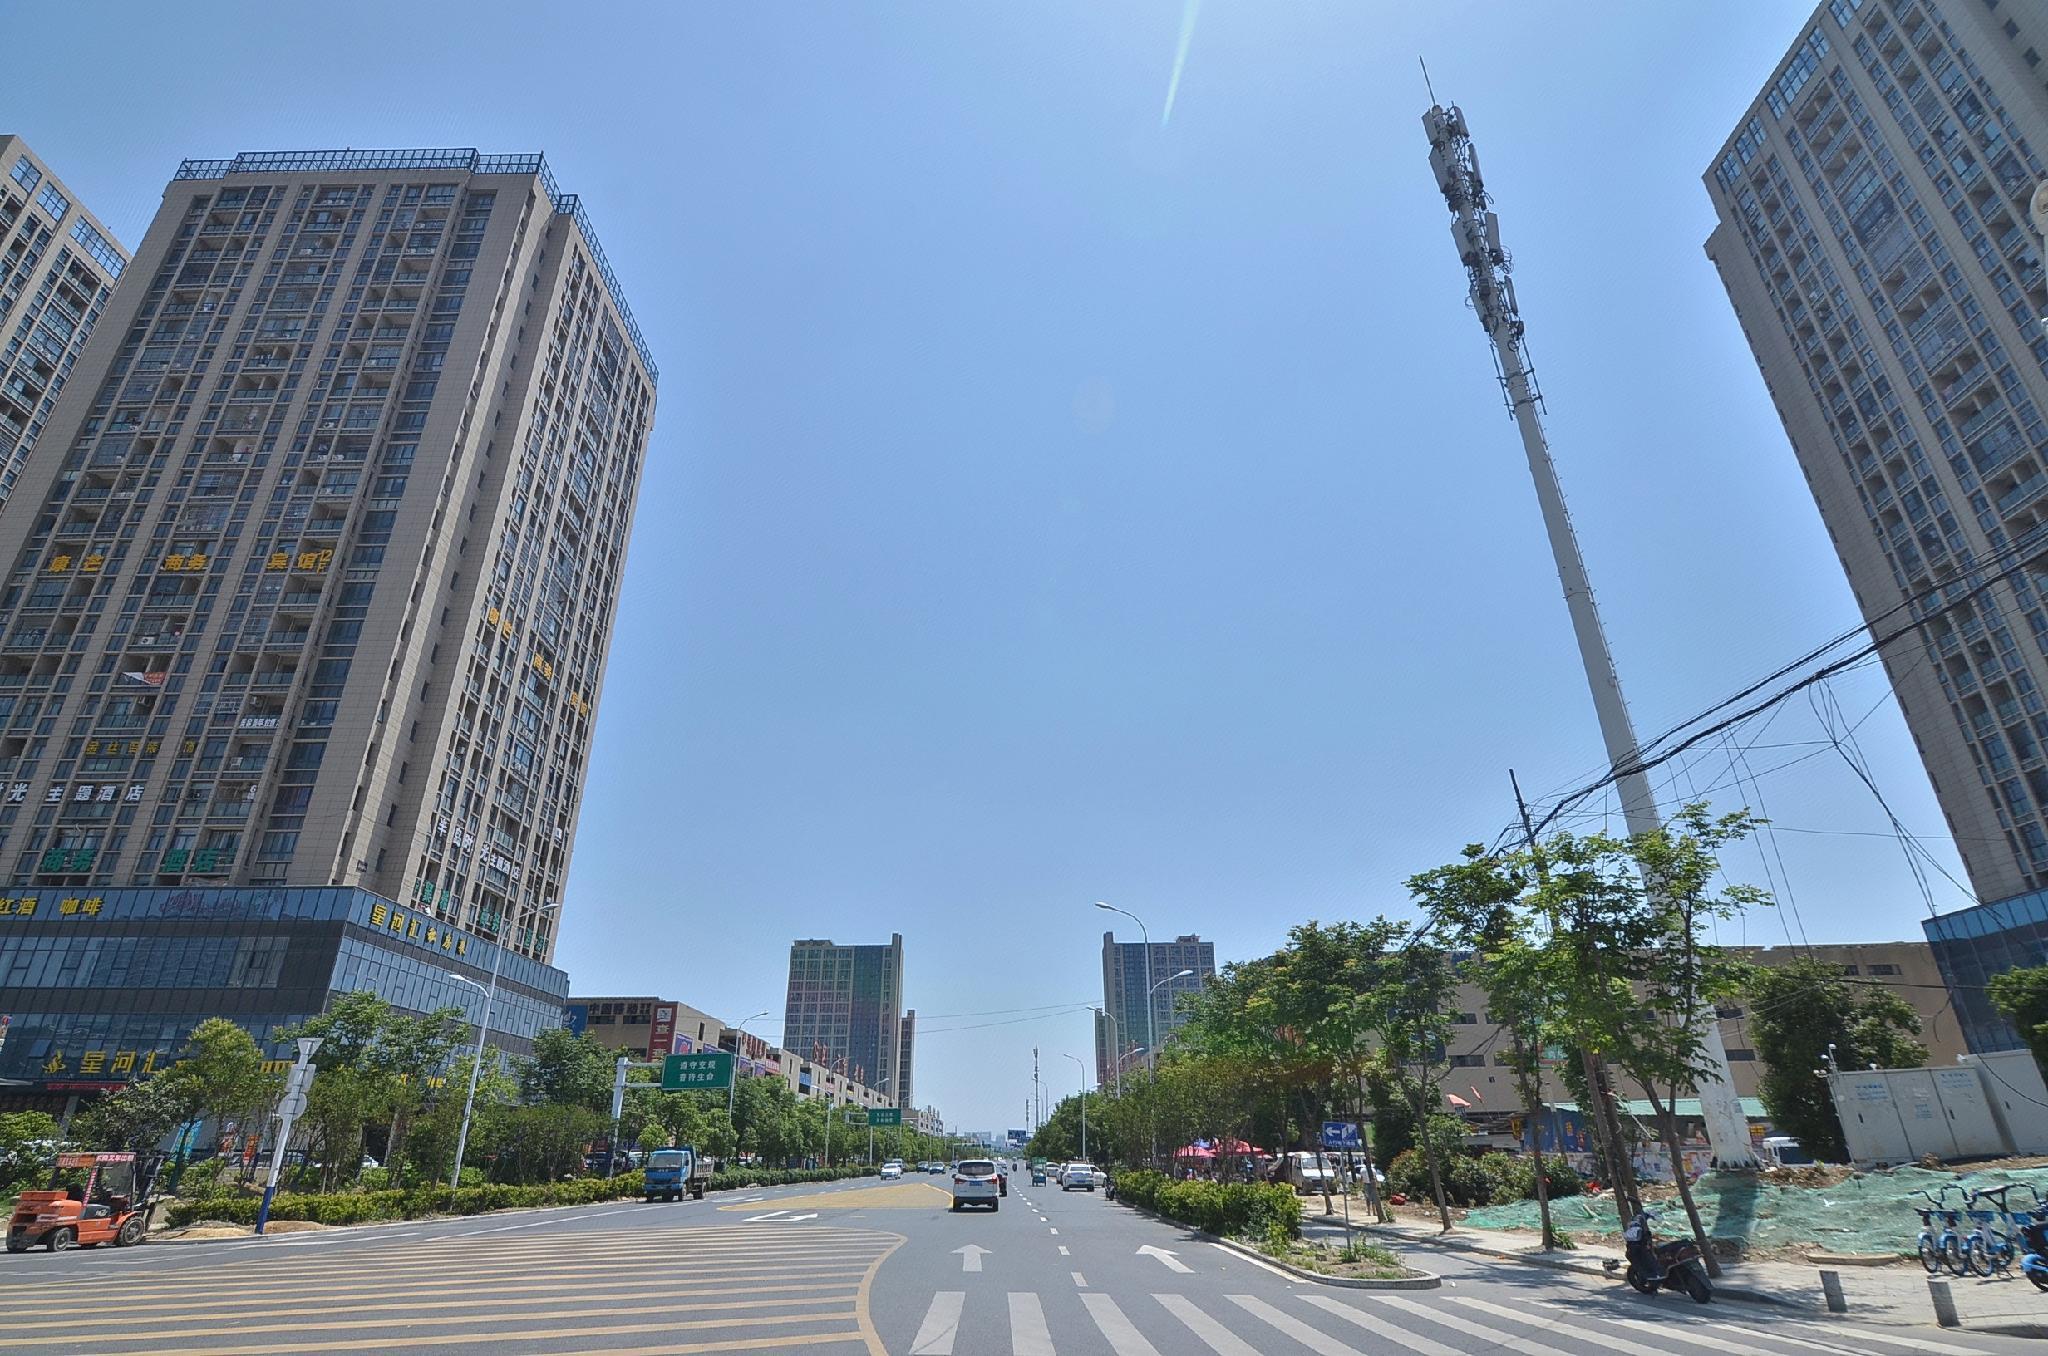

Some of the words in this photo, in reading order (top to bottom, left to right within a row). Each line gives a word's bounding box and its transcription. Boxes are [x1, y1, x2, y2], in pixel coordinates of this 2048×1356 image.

[59, 896, 105, 917] 咖啡
[79, 1050, 169, 1075] 星河汇
